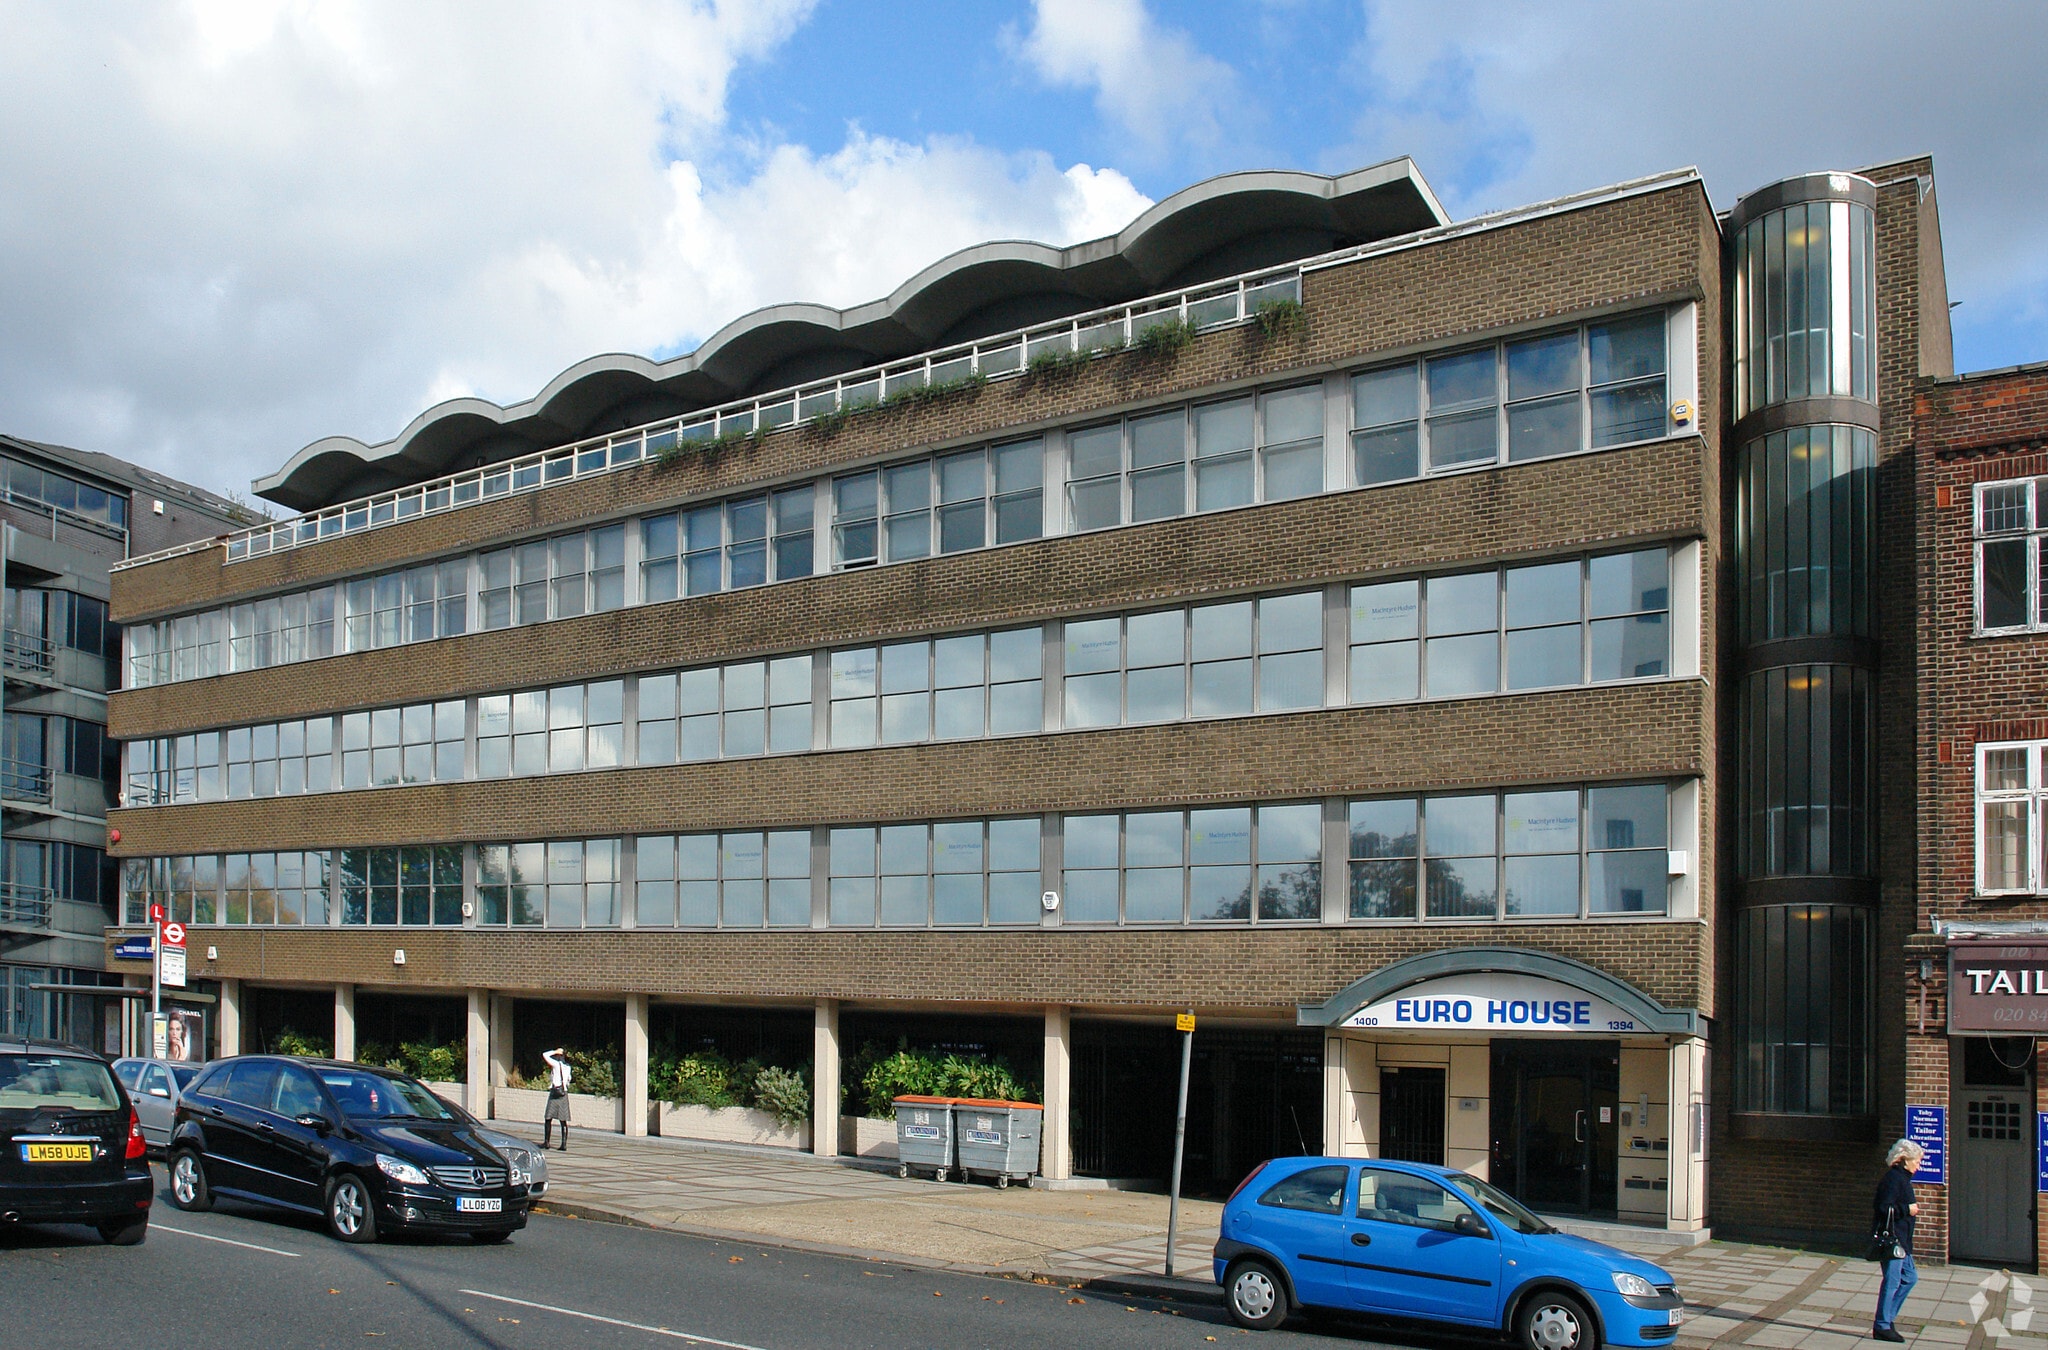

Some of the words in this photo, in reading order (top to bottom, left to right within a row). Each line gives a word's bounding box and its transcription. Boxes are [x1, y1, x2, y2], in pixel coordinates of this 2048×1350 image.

[1397, 603, 1416, 611] Hudson
[154, 906, 162, 918] L
[1354, 1017, 1378, 1025] 1400
[1396, 1000, 1472, 1022] EURO
[1488, 1000, 1590, 1024] HOUSE
[1607, 1021, 1633, 1030] 1394
[1993, 1008, 2024, 1021] 020
[30, 1147, 63, 1159] LM58
[66, 1147, 89, 1159] UJE
[462, 1200, 486, 1210] LL08
[487, 1200, 500, 1210] YZG
